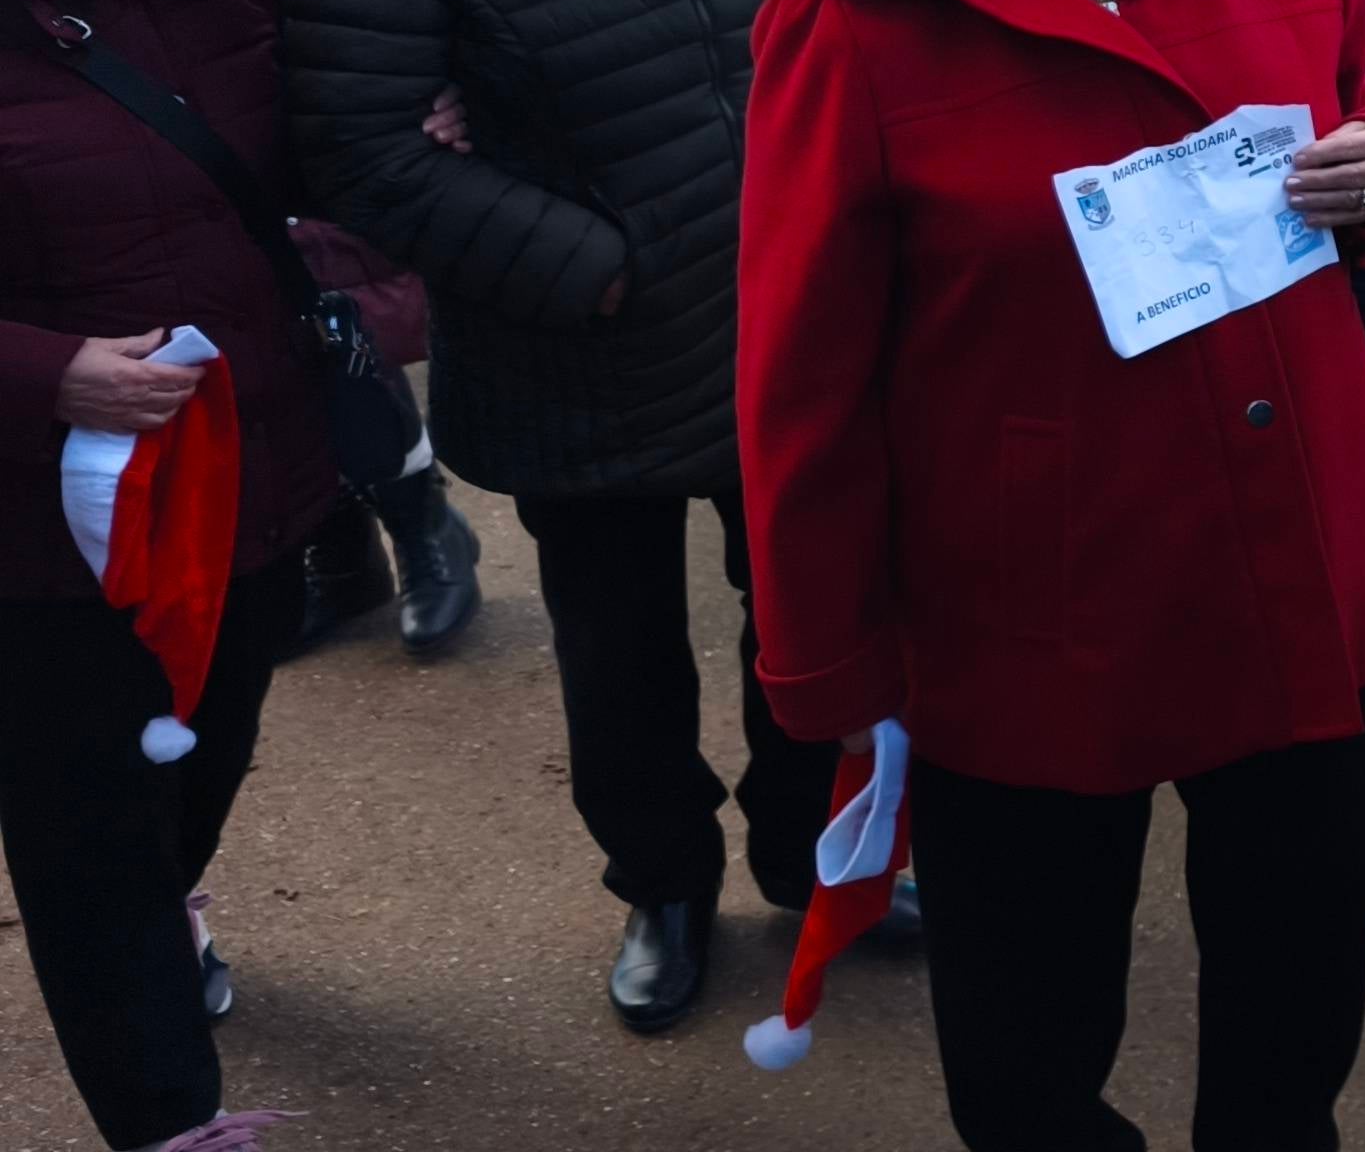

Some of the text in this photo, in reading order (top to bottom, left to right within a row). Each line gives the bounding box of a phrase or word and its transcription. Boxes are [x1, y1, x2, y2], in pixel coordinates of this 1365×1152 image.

[1112, 152, 1164, 183] MARCHA
[1167, 127, 1238, 161] SOLIDARIA
[1136, 281, 1212, 324] A BENEFICIO
